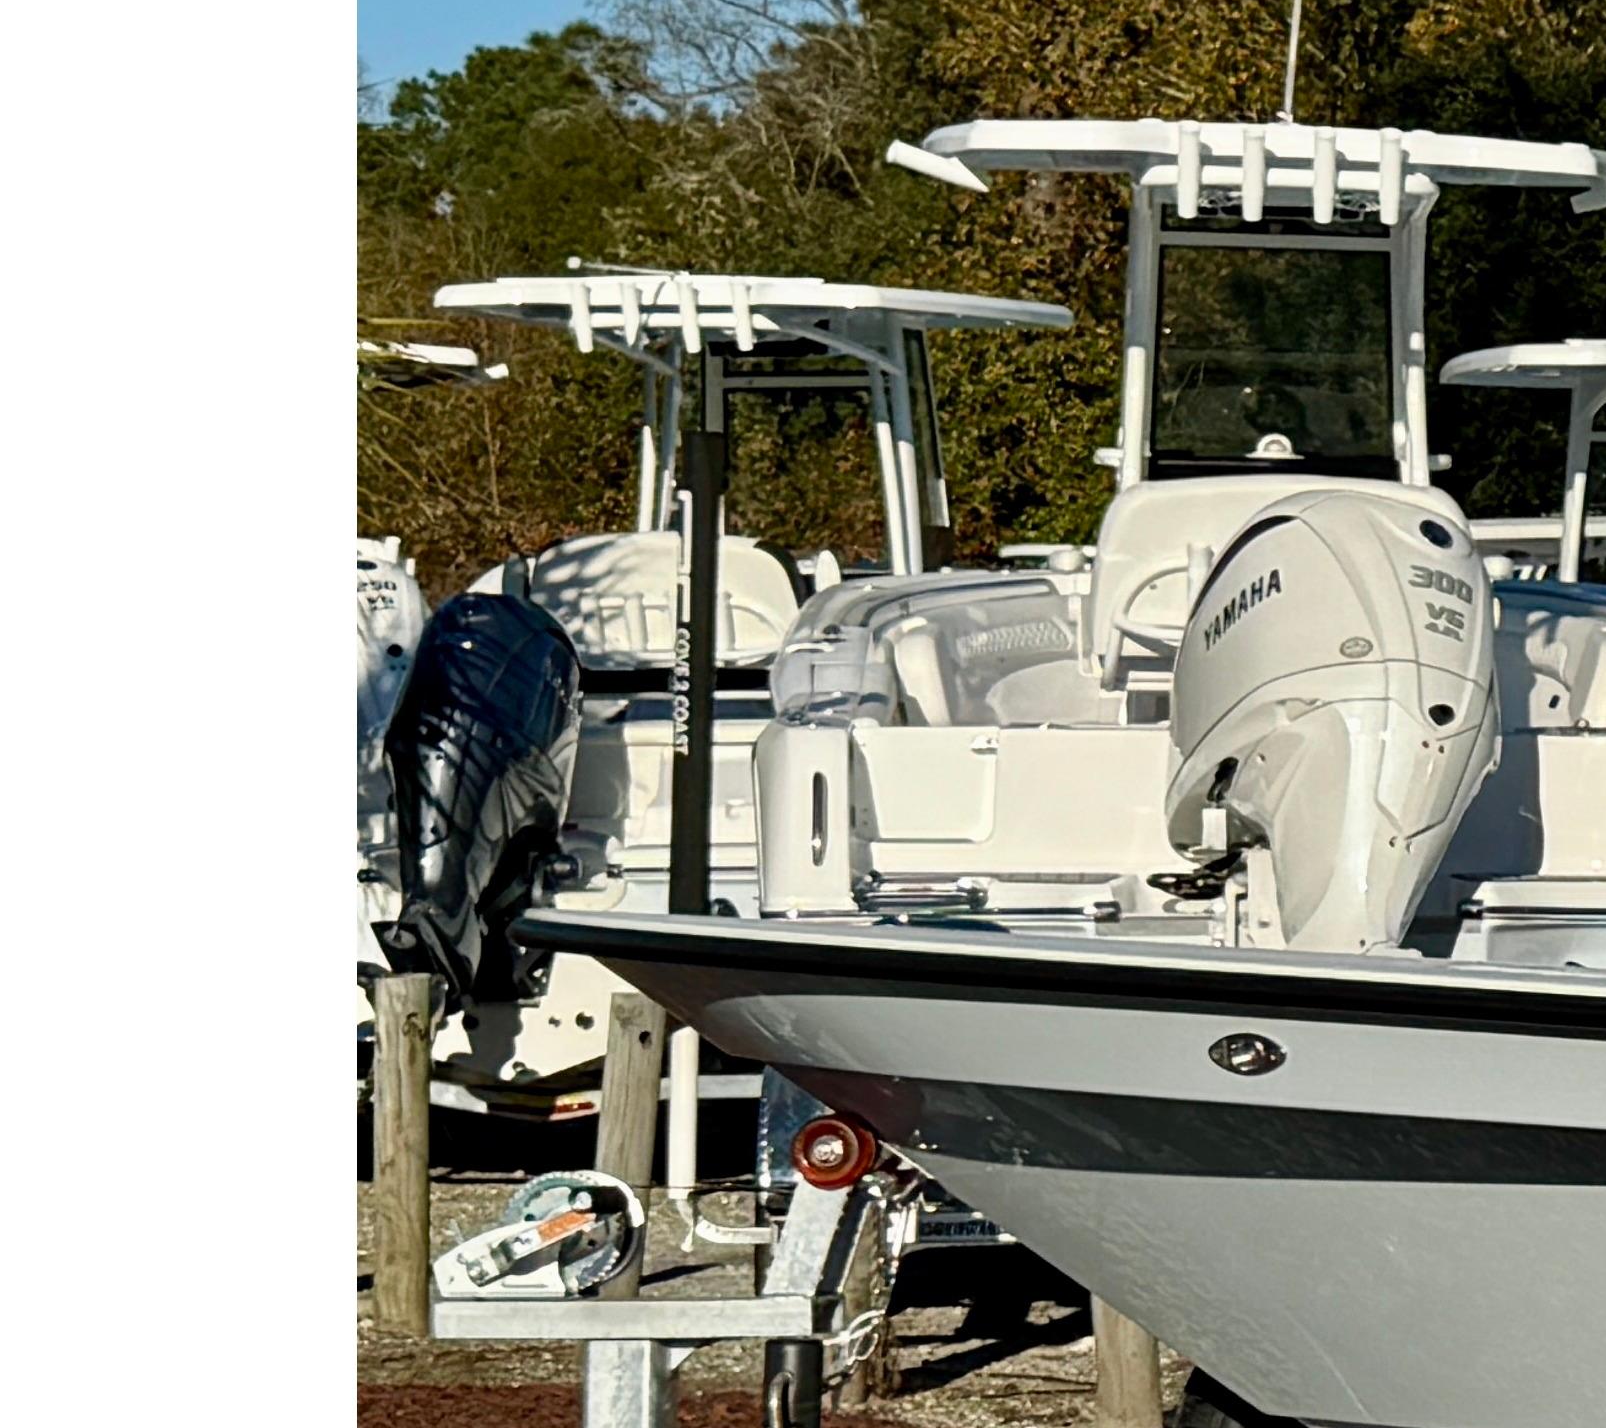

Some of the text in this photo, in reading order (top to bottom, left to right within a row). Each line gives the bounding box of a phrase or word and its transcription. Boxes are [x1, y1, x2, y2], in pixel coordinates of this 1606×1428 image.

[1407, 564, 1473, 605] 300
[1204, 569, 1282, 651] YAMAHA
[1424, 601, 1465, 630] V6
